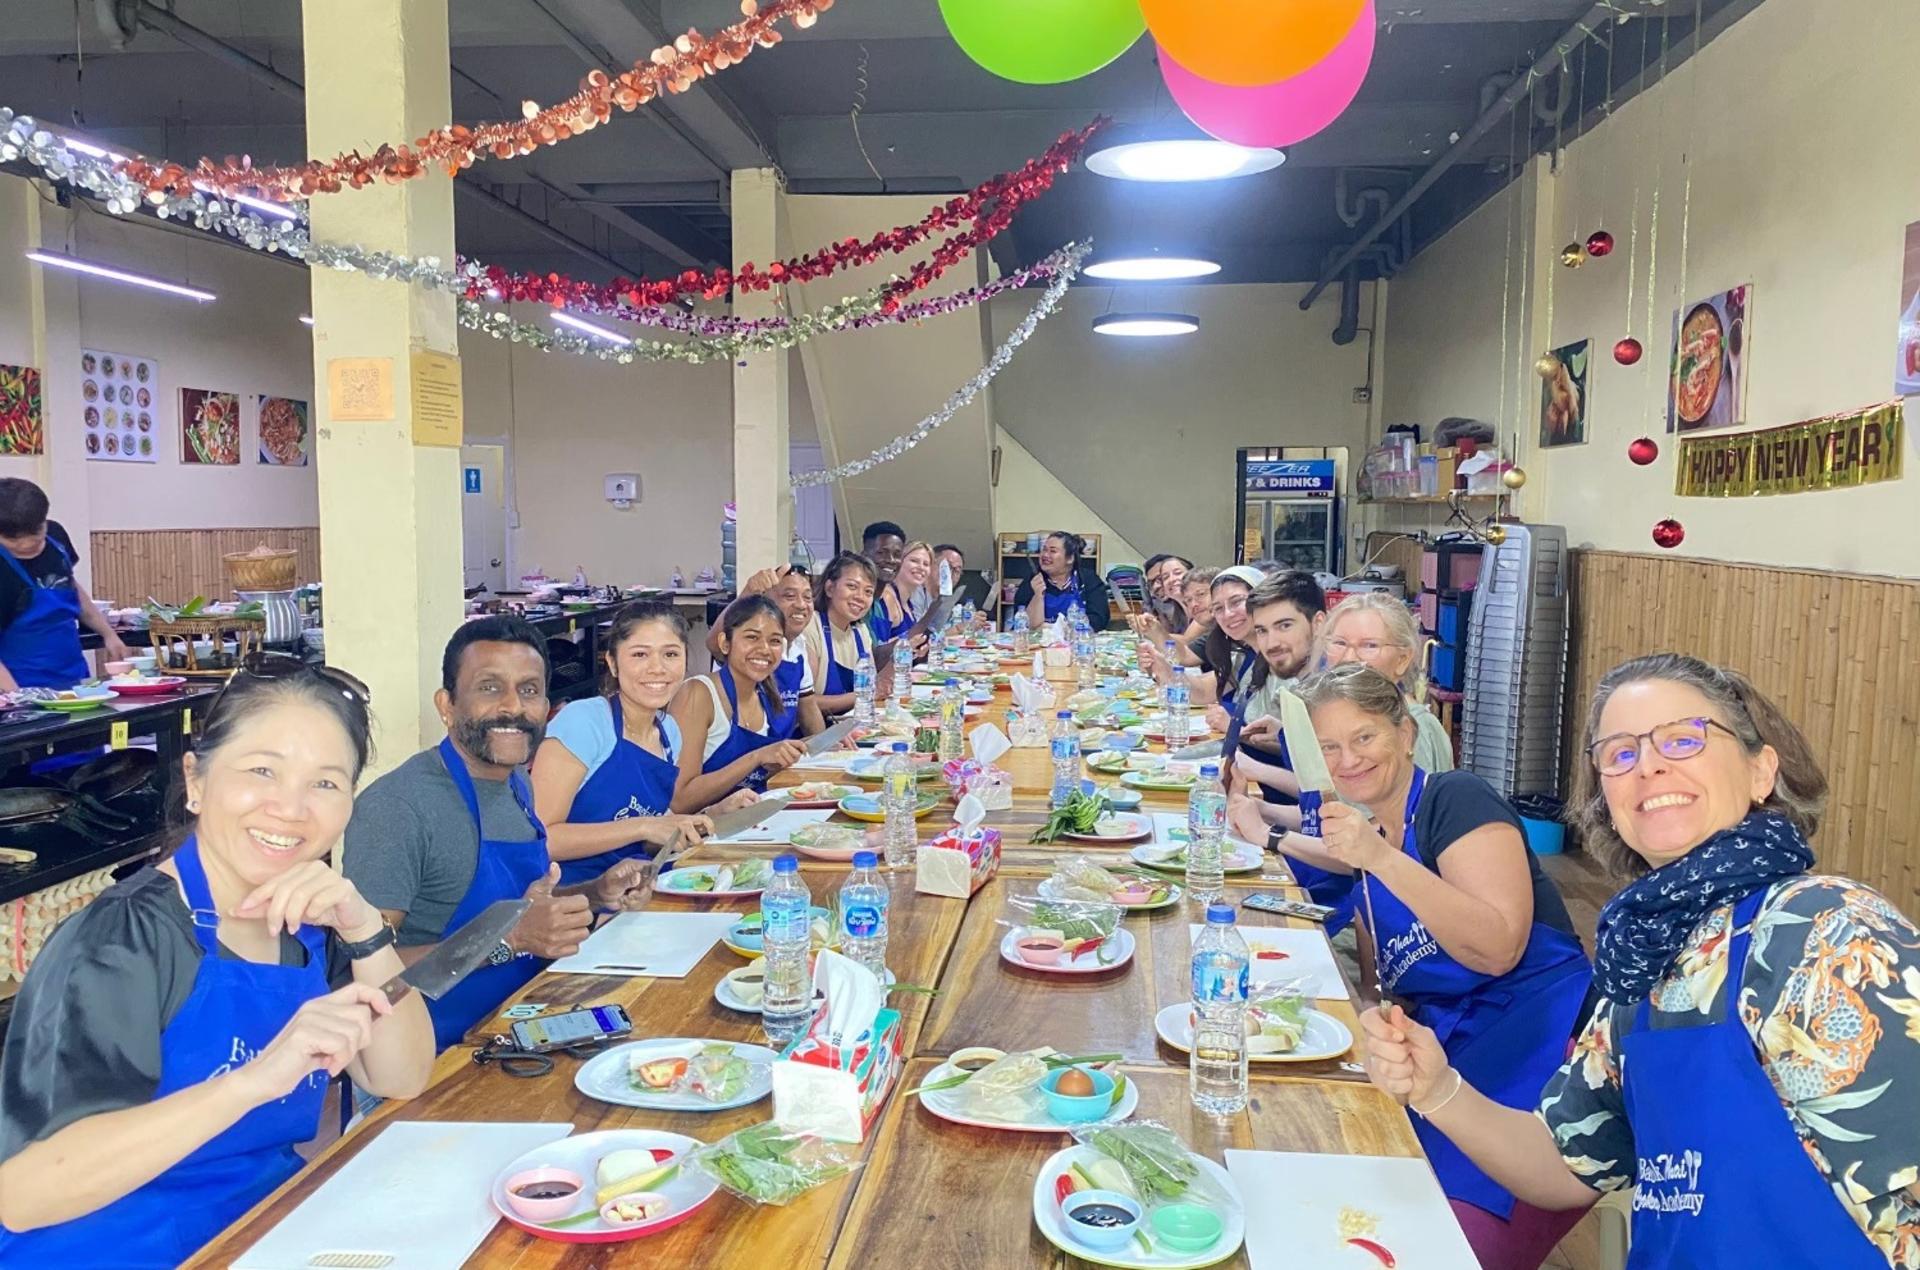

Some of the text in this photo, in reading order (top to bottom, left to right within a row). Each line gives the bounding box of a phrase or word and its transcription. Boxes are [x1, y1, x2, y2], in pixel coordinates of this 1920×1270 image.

[1691, 423, 1882, 484] HAPPY NEW YEAR
[1247, 463, 1312, 475] EEZER
[1256, 478, 1265, 487] &
[1269, 477, 1321, 487] DRINKS
[1656, 1154, 1687, 1181] Thai
